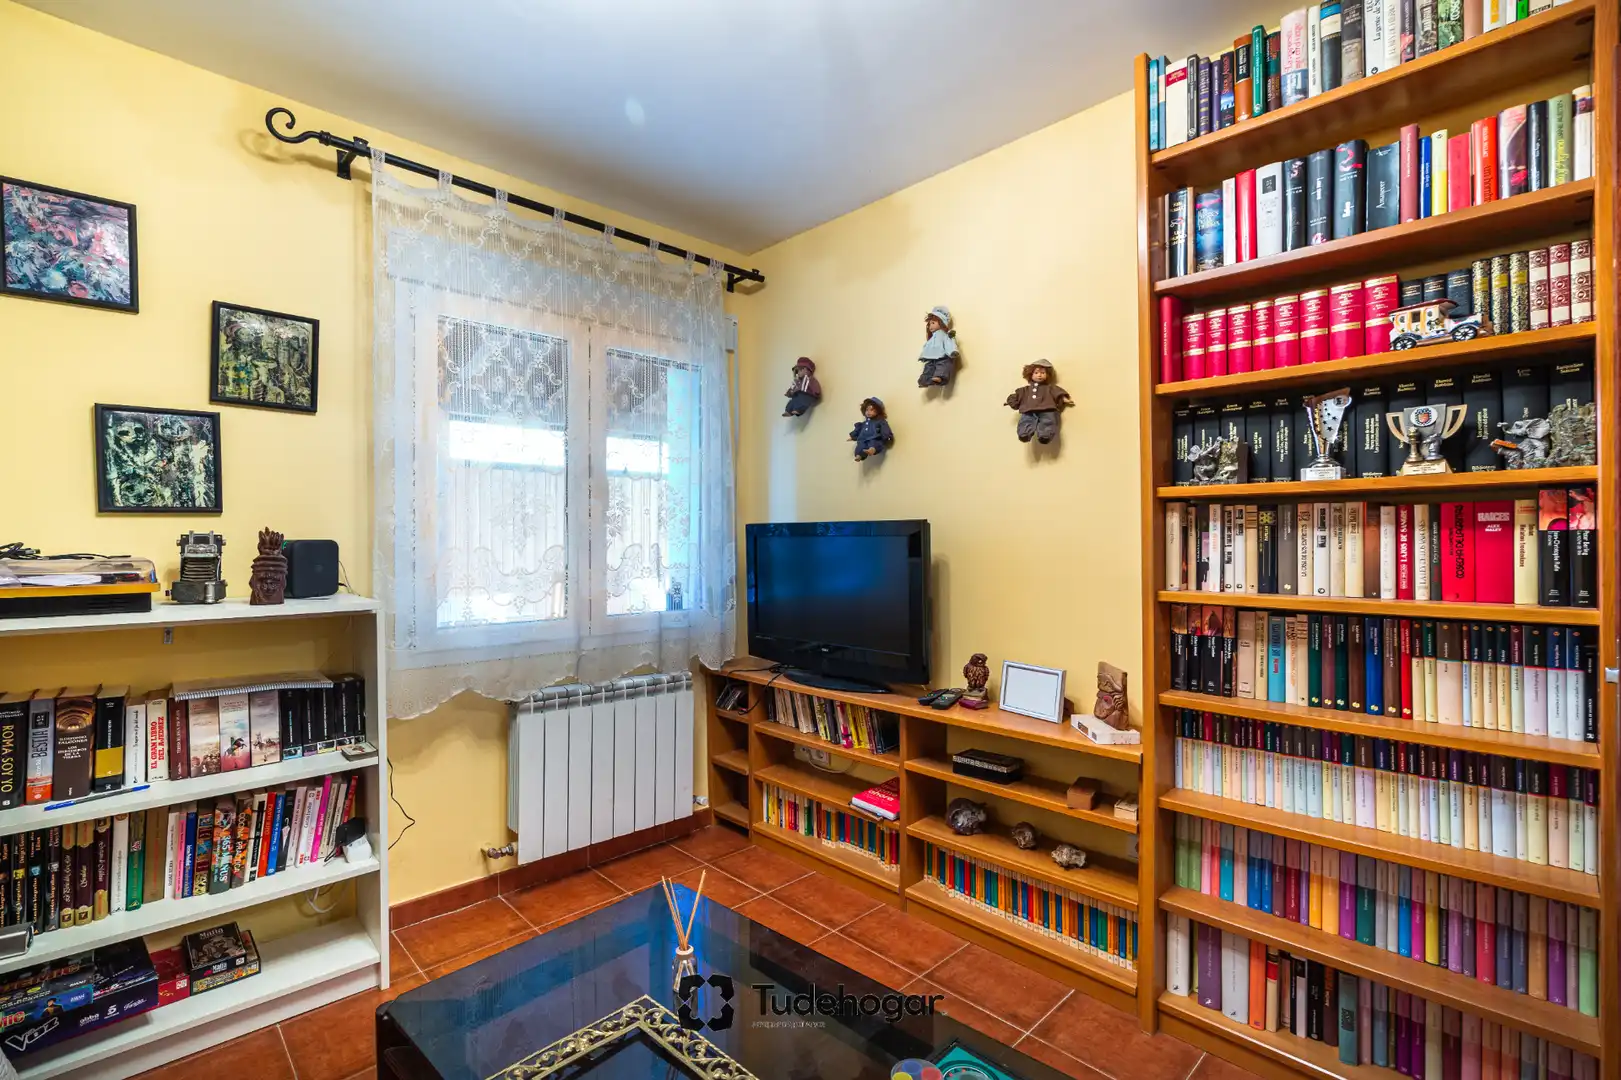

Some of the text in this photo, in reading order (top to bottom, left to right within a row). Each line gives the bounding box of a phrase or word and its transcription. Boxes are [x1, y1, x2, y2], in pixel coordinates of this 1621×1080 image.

[31, 729, 48, 759] BESTIA
[1, 725, 15, 793] ROMA SOY YO
[151, 761, 158, 769] EL
[222, 836, 231, 850] 365
[200, 928, 224, 938] Mafia
